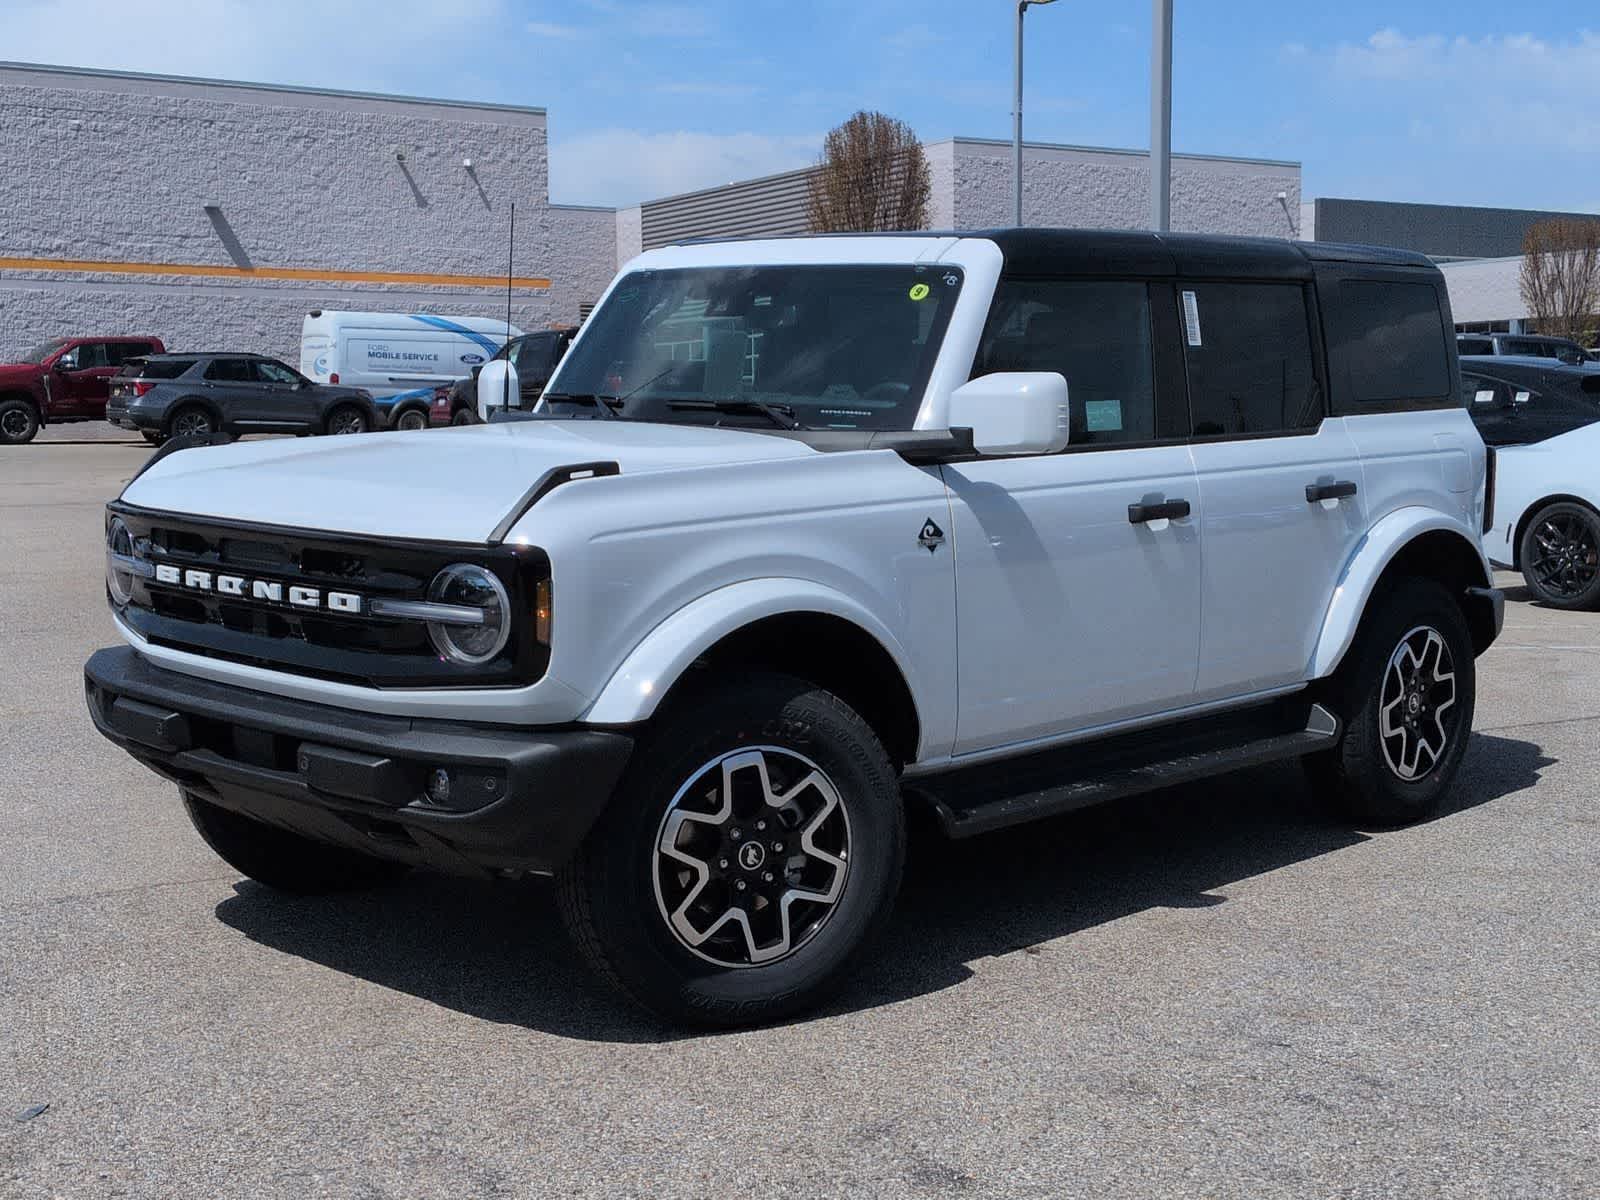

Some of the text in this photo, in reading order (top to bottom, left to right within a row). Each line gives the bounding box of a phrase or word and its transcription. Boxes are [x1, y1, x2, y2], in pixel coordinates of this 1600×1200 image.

[367, 351, 439, 361] MOBILE SERVICE
[156, 564, 361, 613] BRONCO
